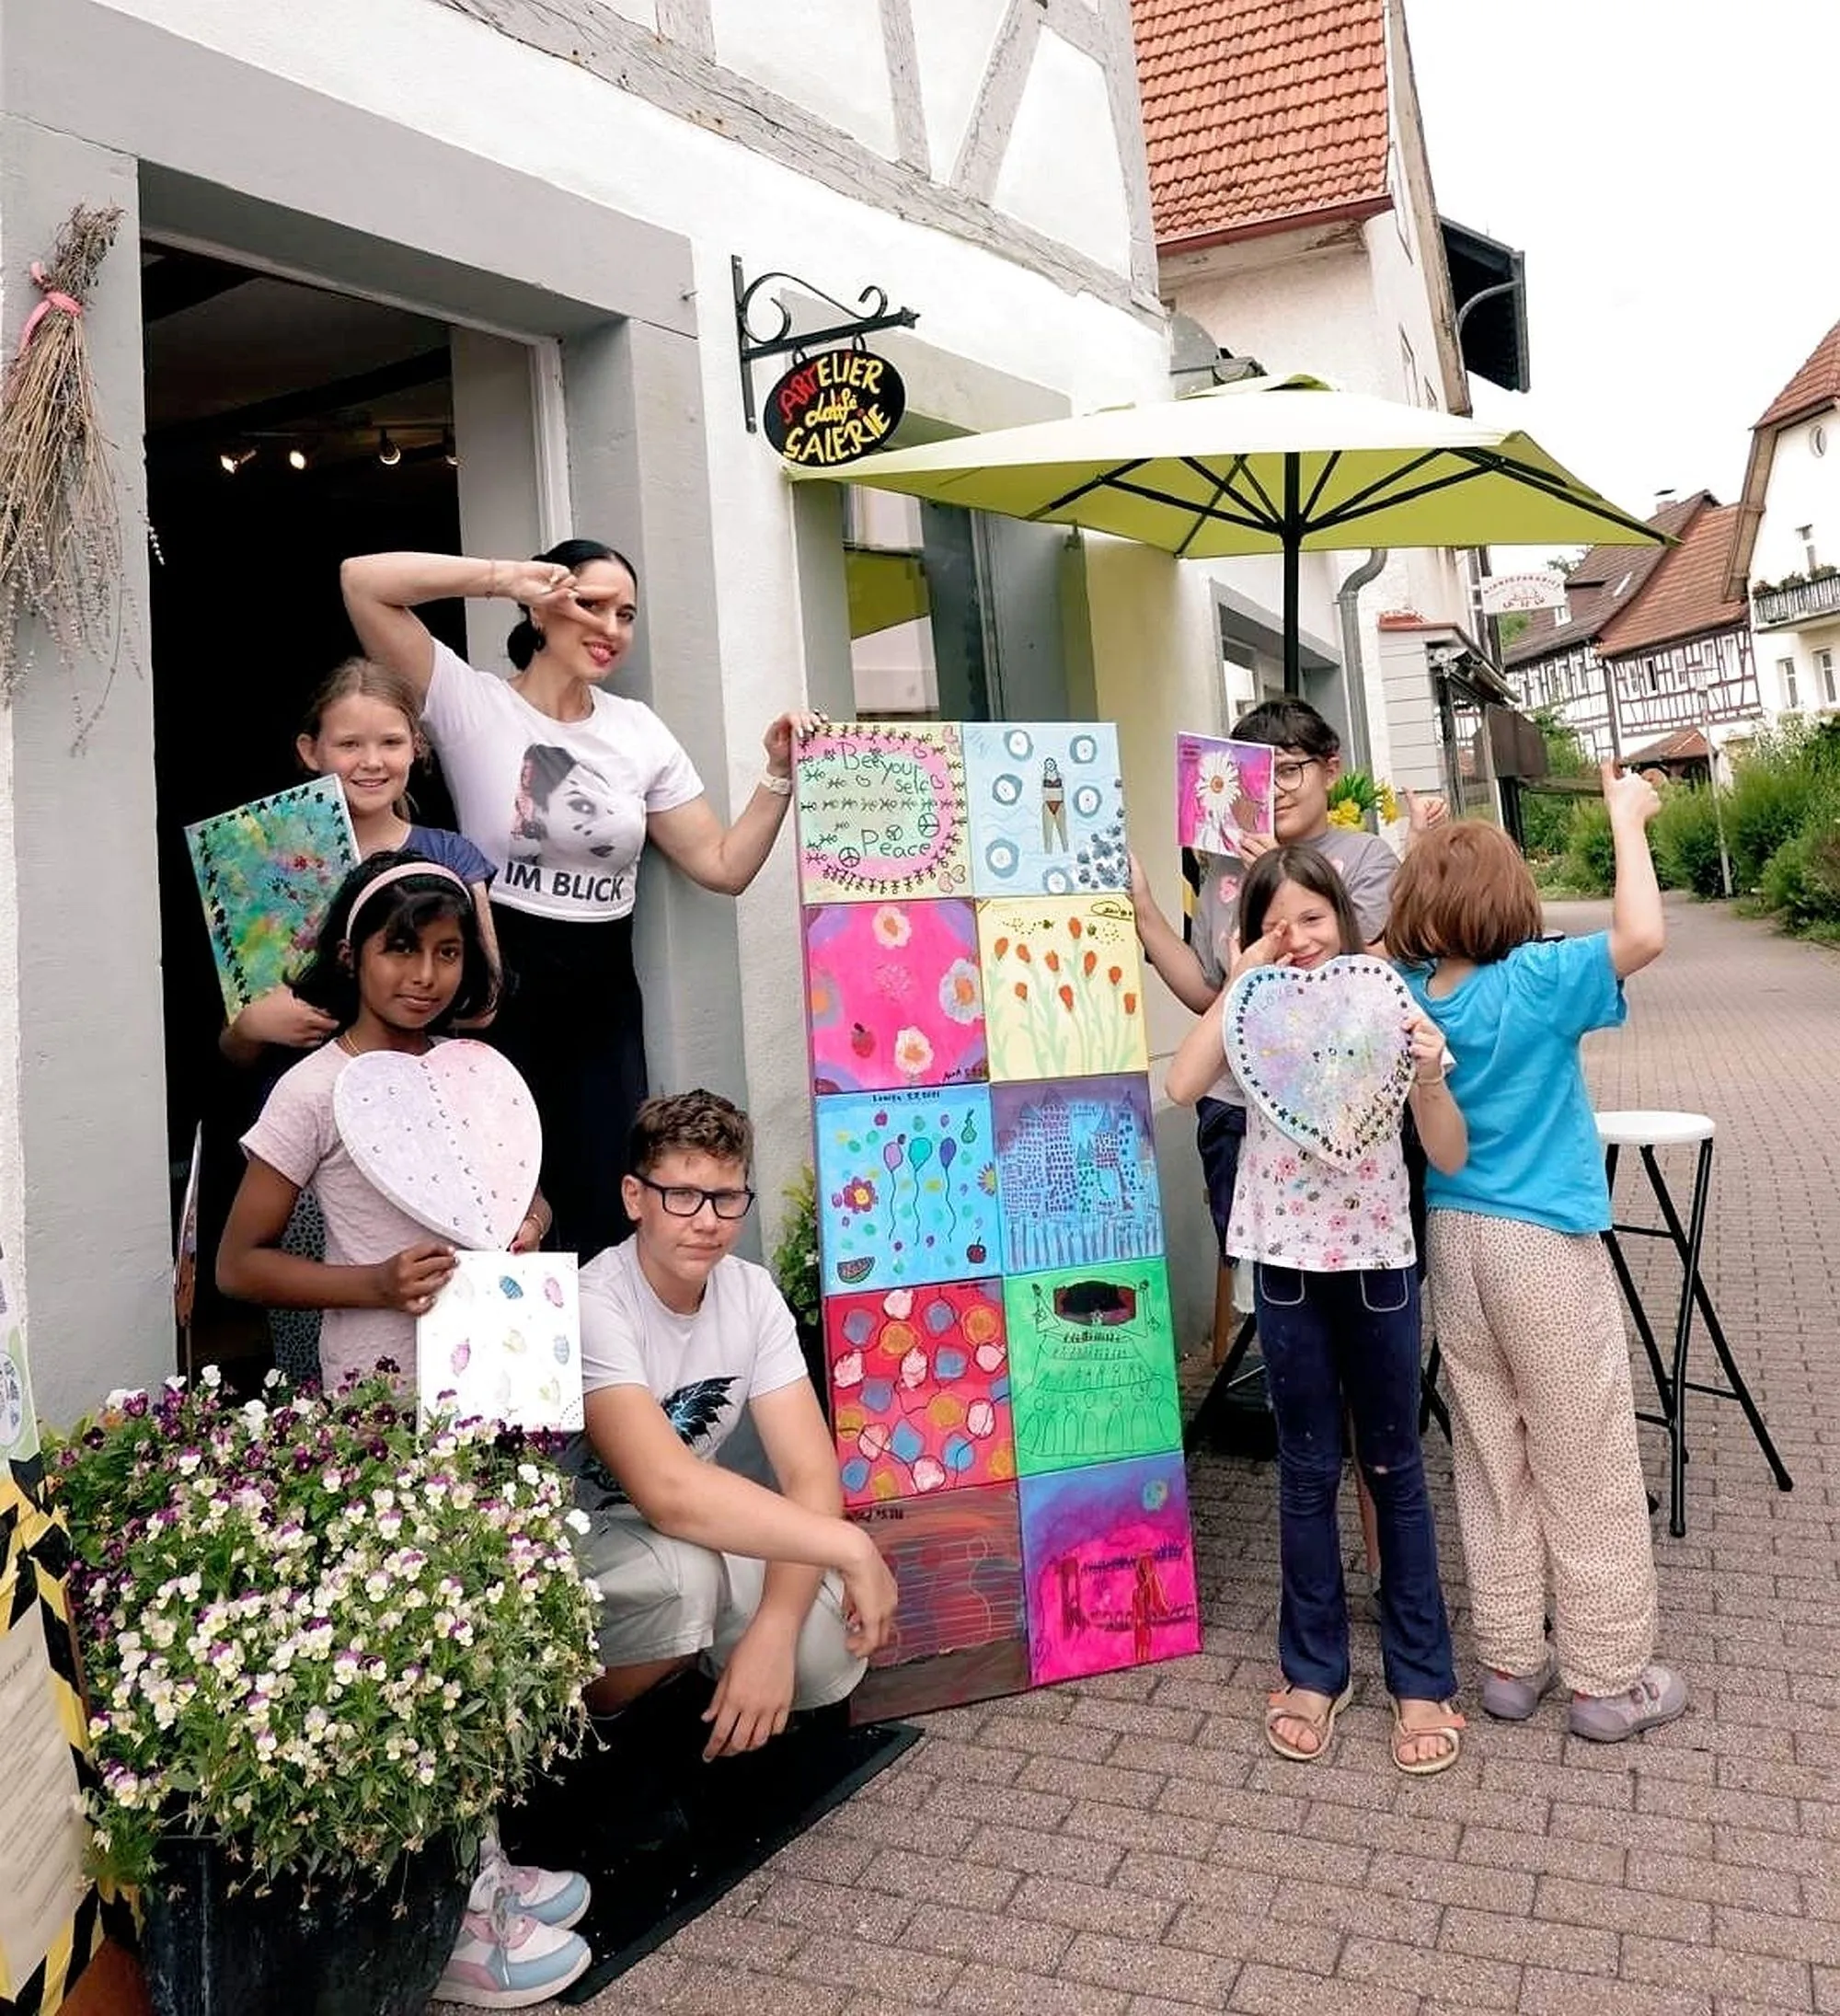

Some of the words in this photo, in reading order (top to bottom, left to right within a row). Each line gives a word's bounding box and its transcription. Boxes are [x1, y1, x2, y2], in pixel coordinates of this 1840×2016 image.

[784, 404, 891, 464] GALERIE
[861, 829, 931, 858] Peace
[505, 860, 542, 893] IM
[551, 871, 624, 903] BLICK
